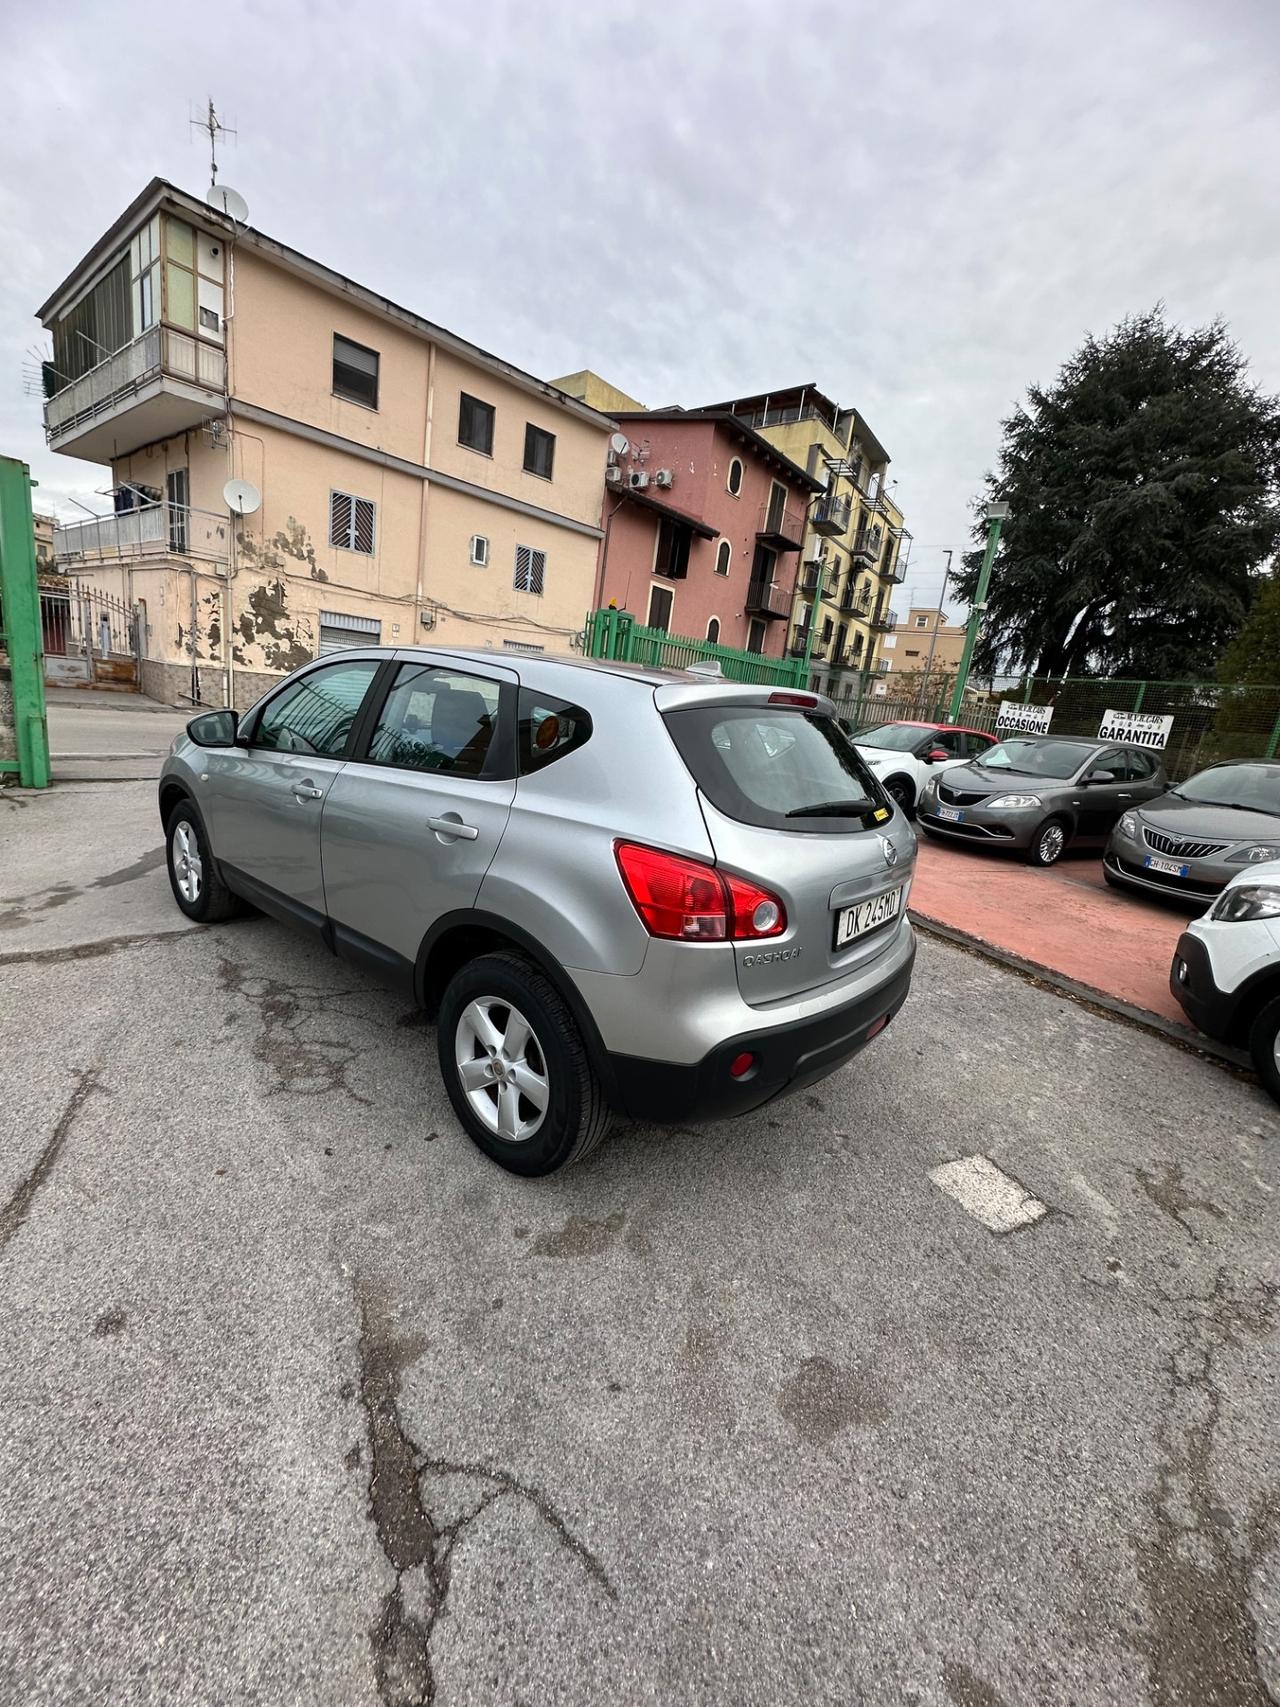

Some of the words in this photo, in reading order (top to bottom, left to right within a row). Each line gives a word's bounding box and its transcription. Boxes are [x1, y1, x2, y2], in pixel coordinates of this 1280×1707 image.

[998, 715, 1048, 734] OCCASIONE
[1099, 726, 1165, 747] GARANTITA
[846, 906, 863, 937] DK
[865, 892, 896, 928] 245MD
[743, 946, 802, 967] QASHQAI
